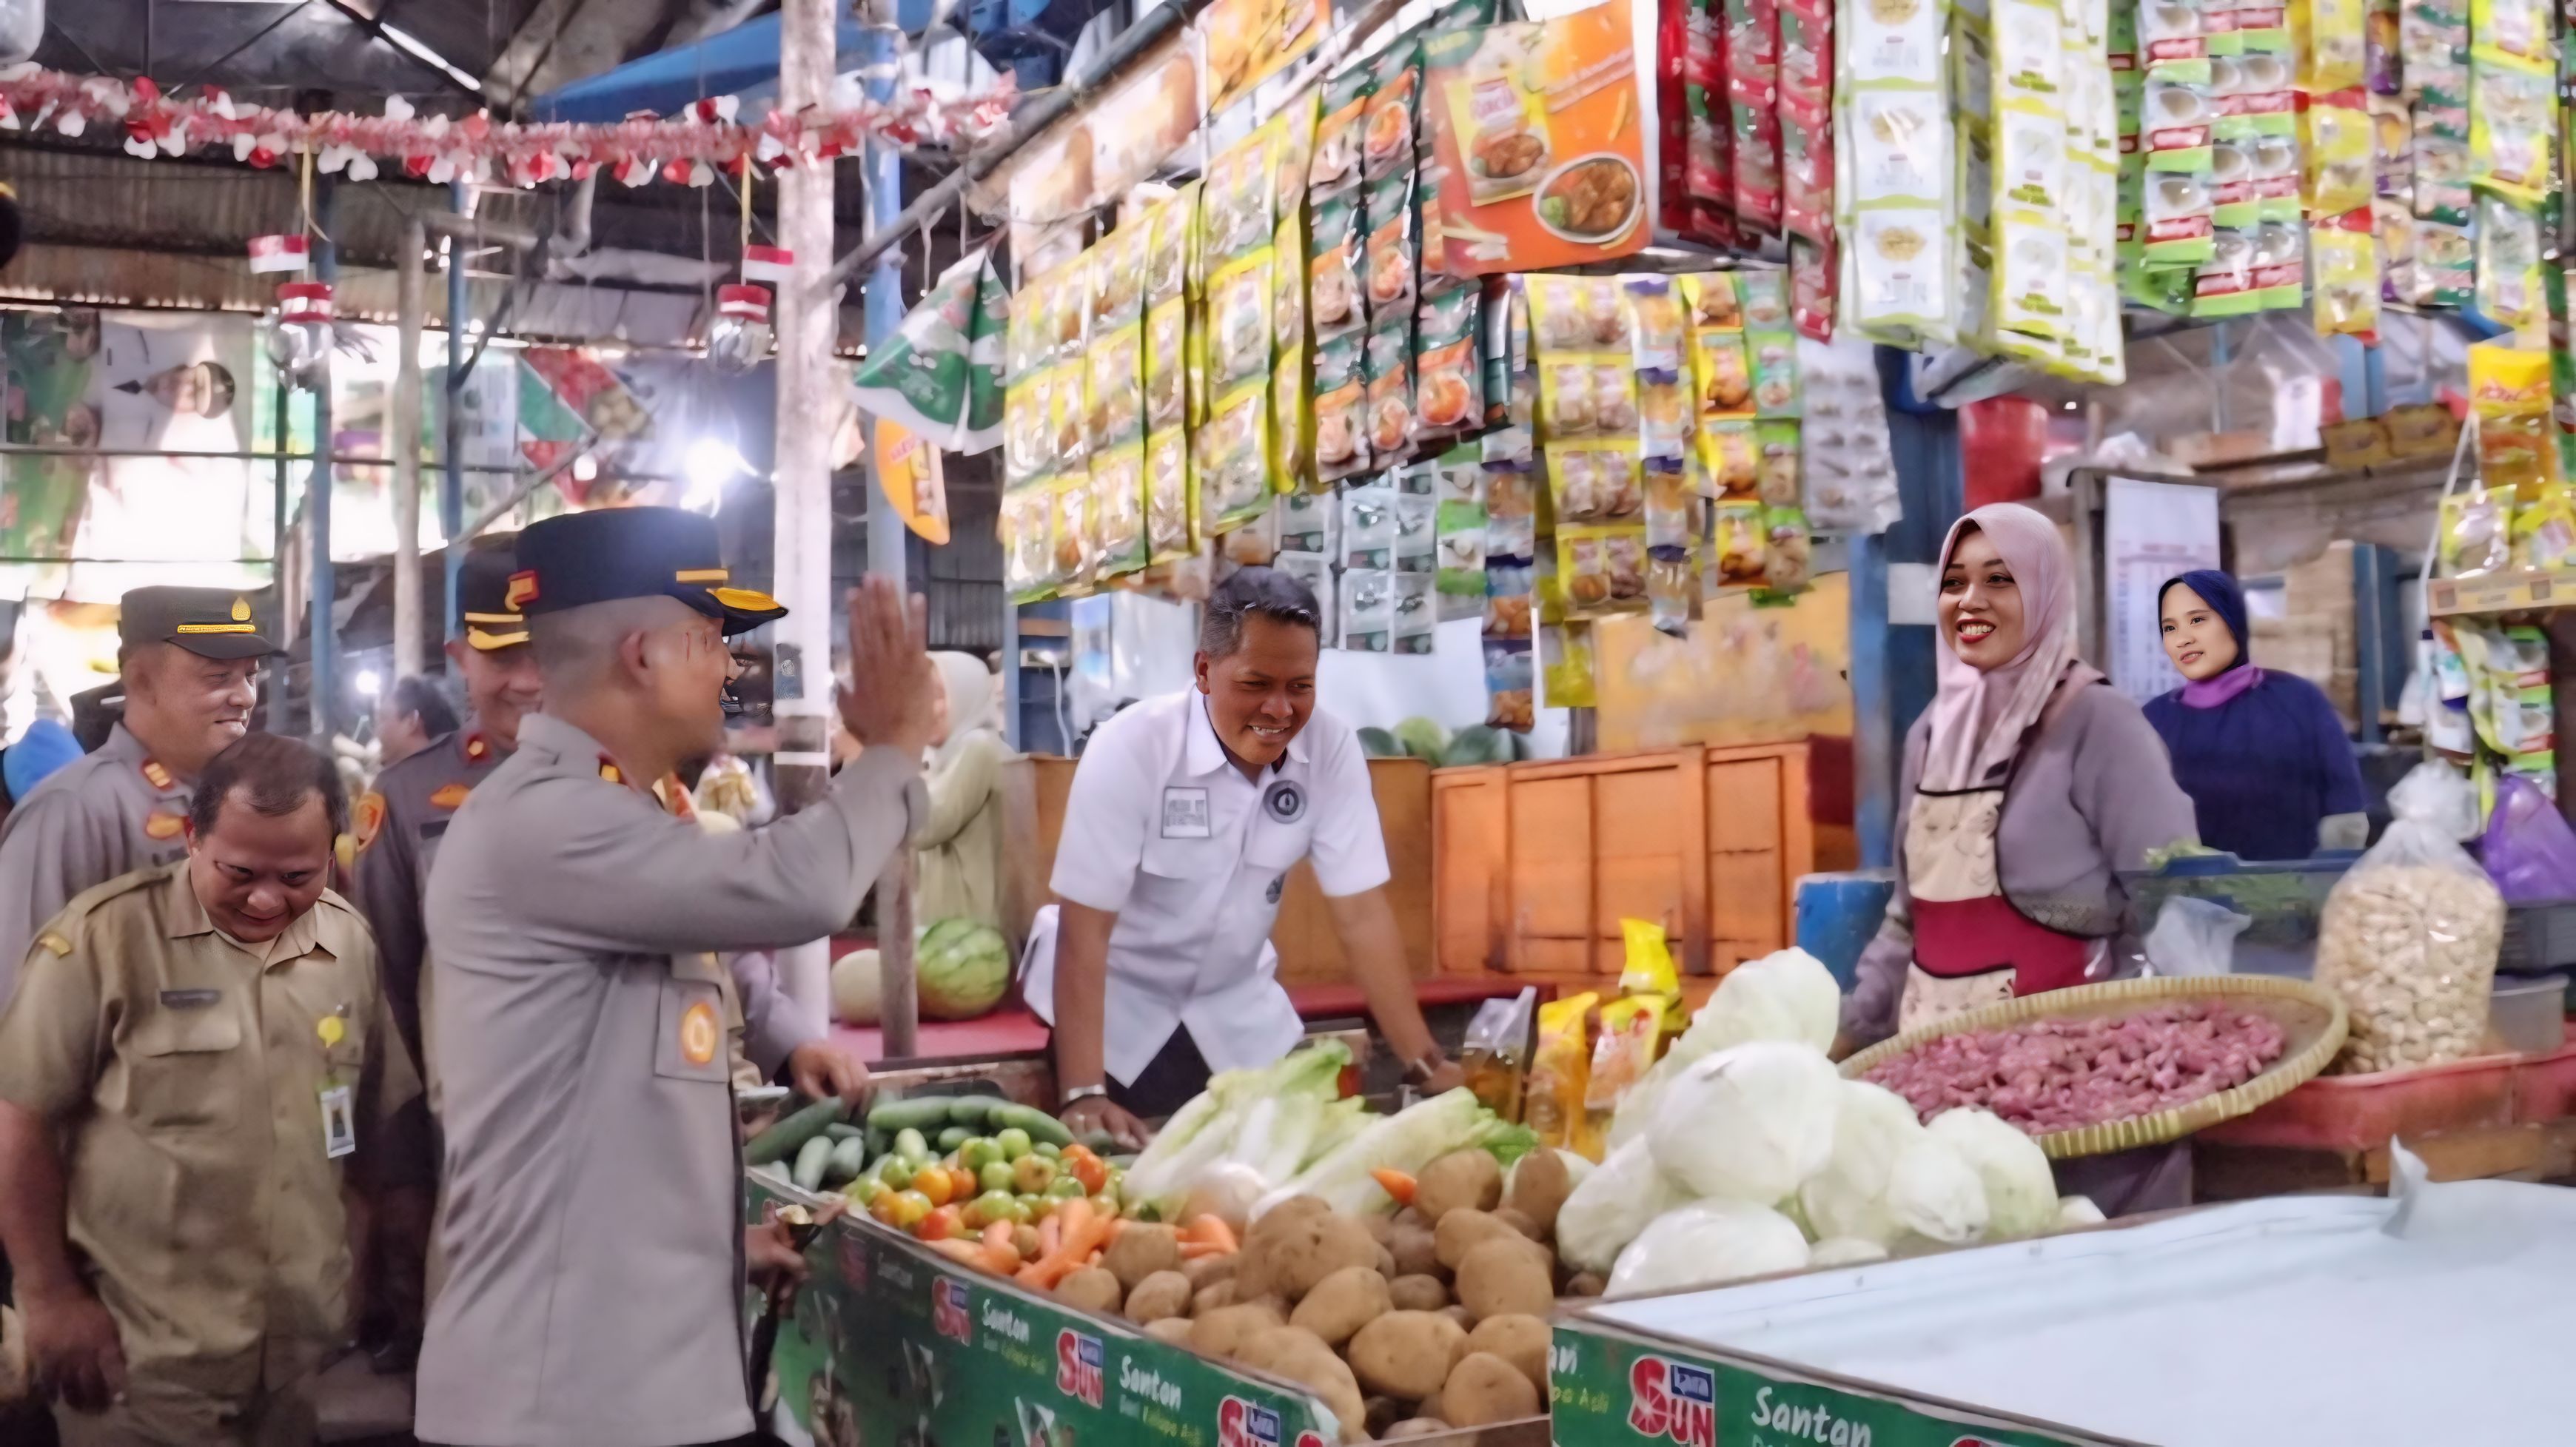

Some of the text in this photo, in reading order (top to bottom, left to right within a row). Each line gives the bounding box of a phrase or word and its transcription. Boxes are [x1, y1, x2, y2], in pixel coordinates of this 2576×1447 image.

[1056, 1327, 1103, 1409] SUN
[1119, 1354, 1182, 1411] Santan
[1631, 1357, 1714, 1447] SUN
[1751, 1391, 1871, 1447] Santan
